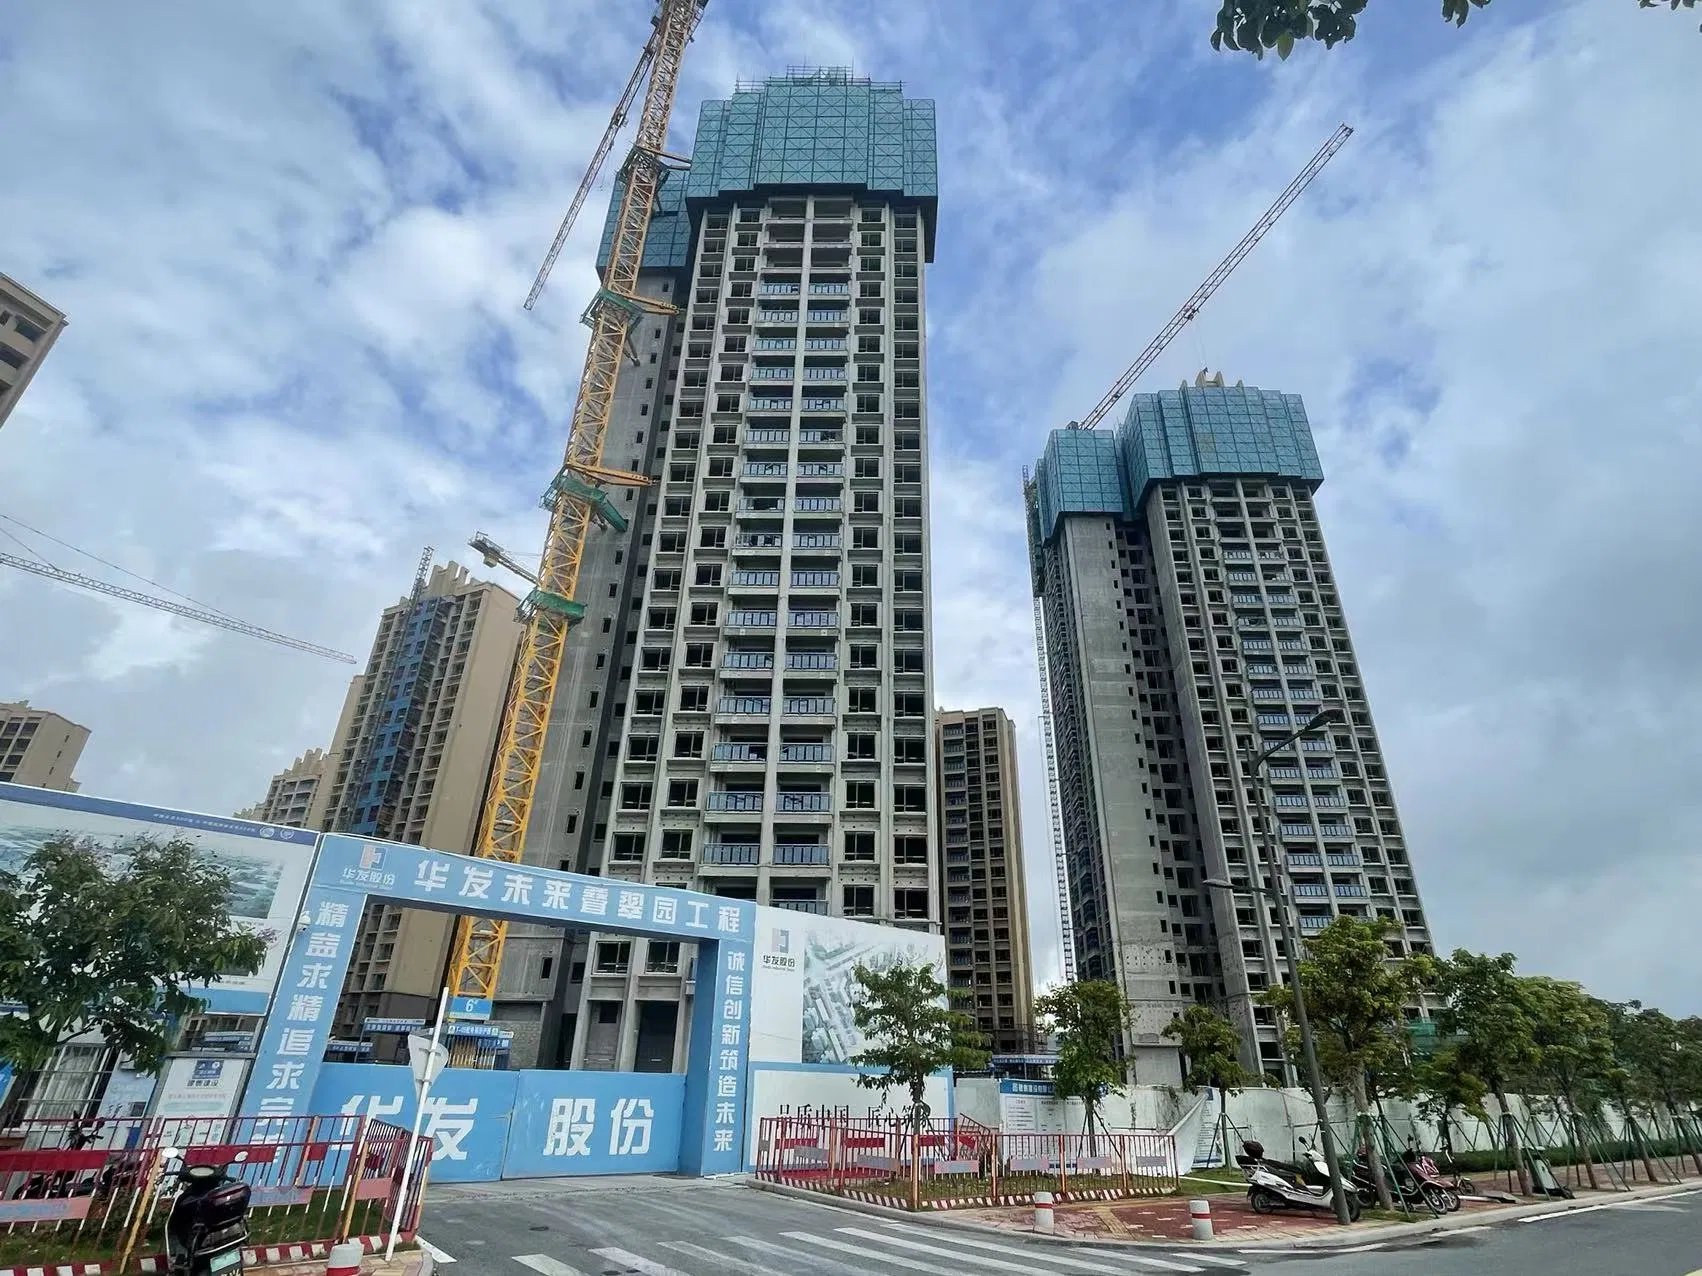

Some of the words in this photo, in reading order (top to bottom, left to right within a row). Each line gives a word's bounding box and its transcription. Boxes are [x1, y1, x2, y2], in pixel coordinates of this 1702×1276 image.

[713, 950, 745, 1152] 诚信创新筑造未来
